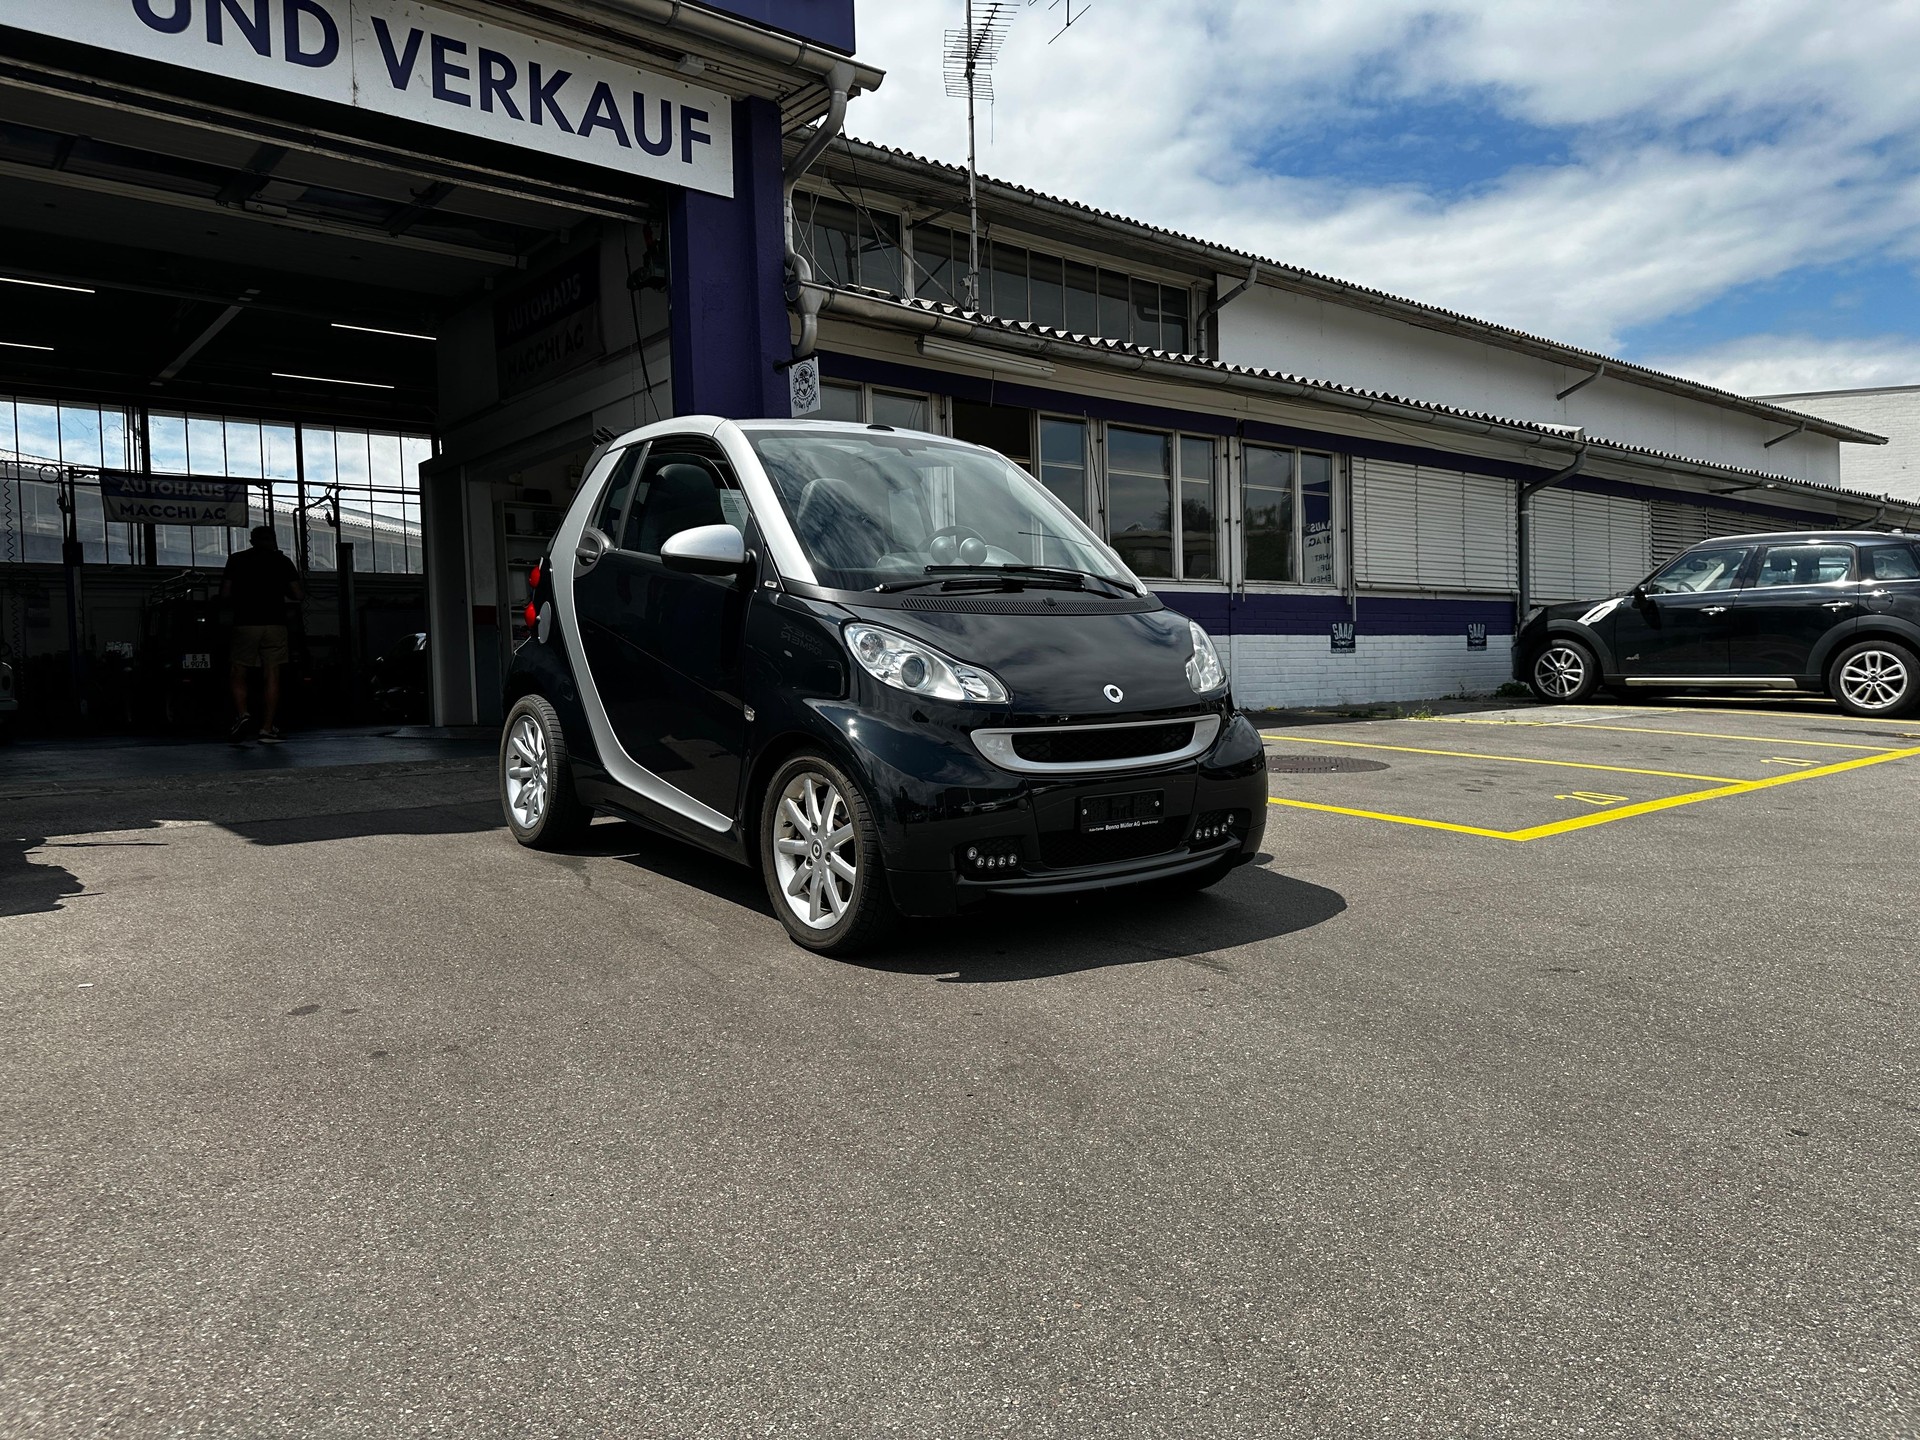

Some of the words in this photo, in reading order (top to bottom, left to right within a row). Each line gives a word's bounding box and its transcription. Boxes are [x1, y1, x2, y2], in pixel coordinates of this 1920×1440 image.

[371, 17, 712, 165] VERKAUF
[506, 273, 581, 336] AUTOHAUS
[506, 334, 561, 381] MACCHI
[565, 323, 584, 355] AG
[120, 479, 225, 497] AUTOHAUS
[120, 503, 197, 519] MACCHI
[202, 507, 227, 520] AG
[1332, 622, 1354, 640] SAAB
[1467, 623, 1486, 639] SAAB
